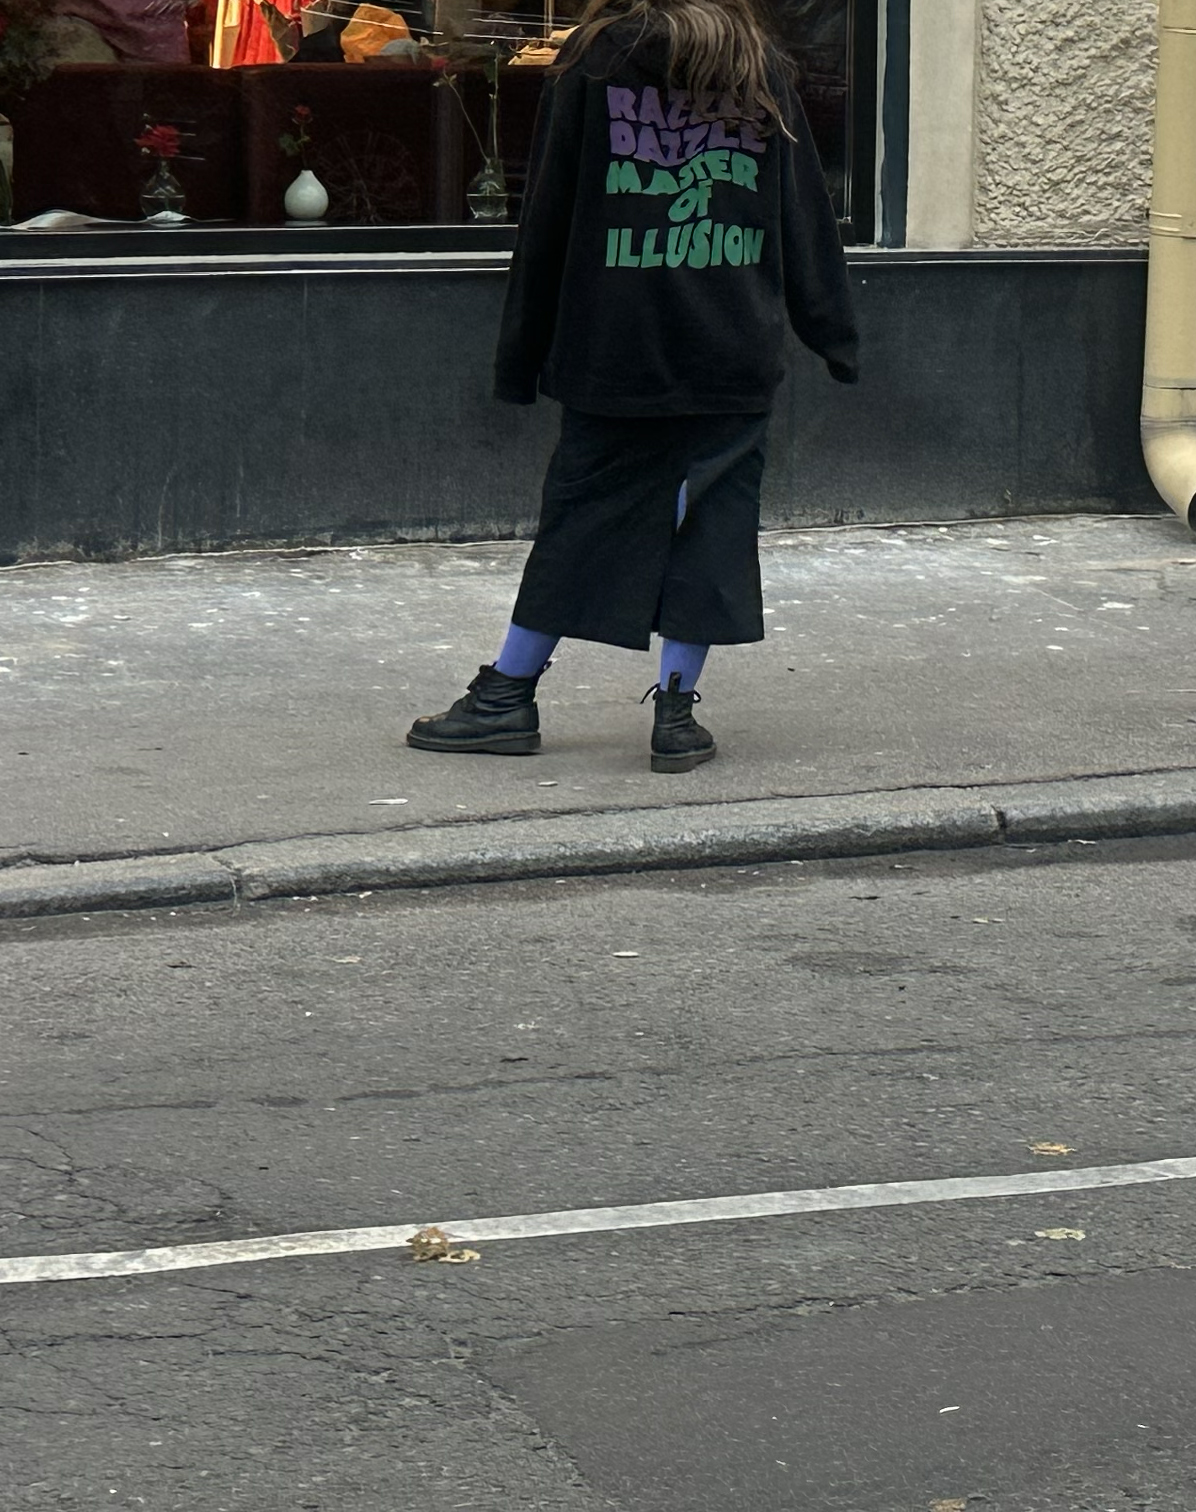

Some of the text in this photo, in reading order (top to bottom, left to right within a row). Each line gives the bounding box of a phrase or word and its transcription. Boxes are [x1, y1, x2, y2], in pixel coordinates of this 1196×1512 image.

[606, 149, 759, 196] MASTER
[667, 178, 714, 223] OF
[605, 218, 765, 270] ILLUSION
